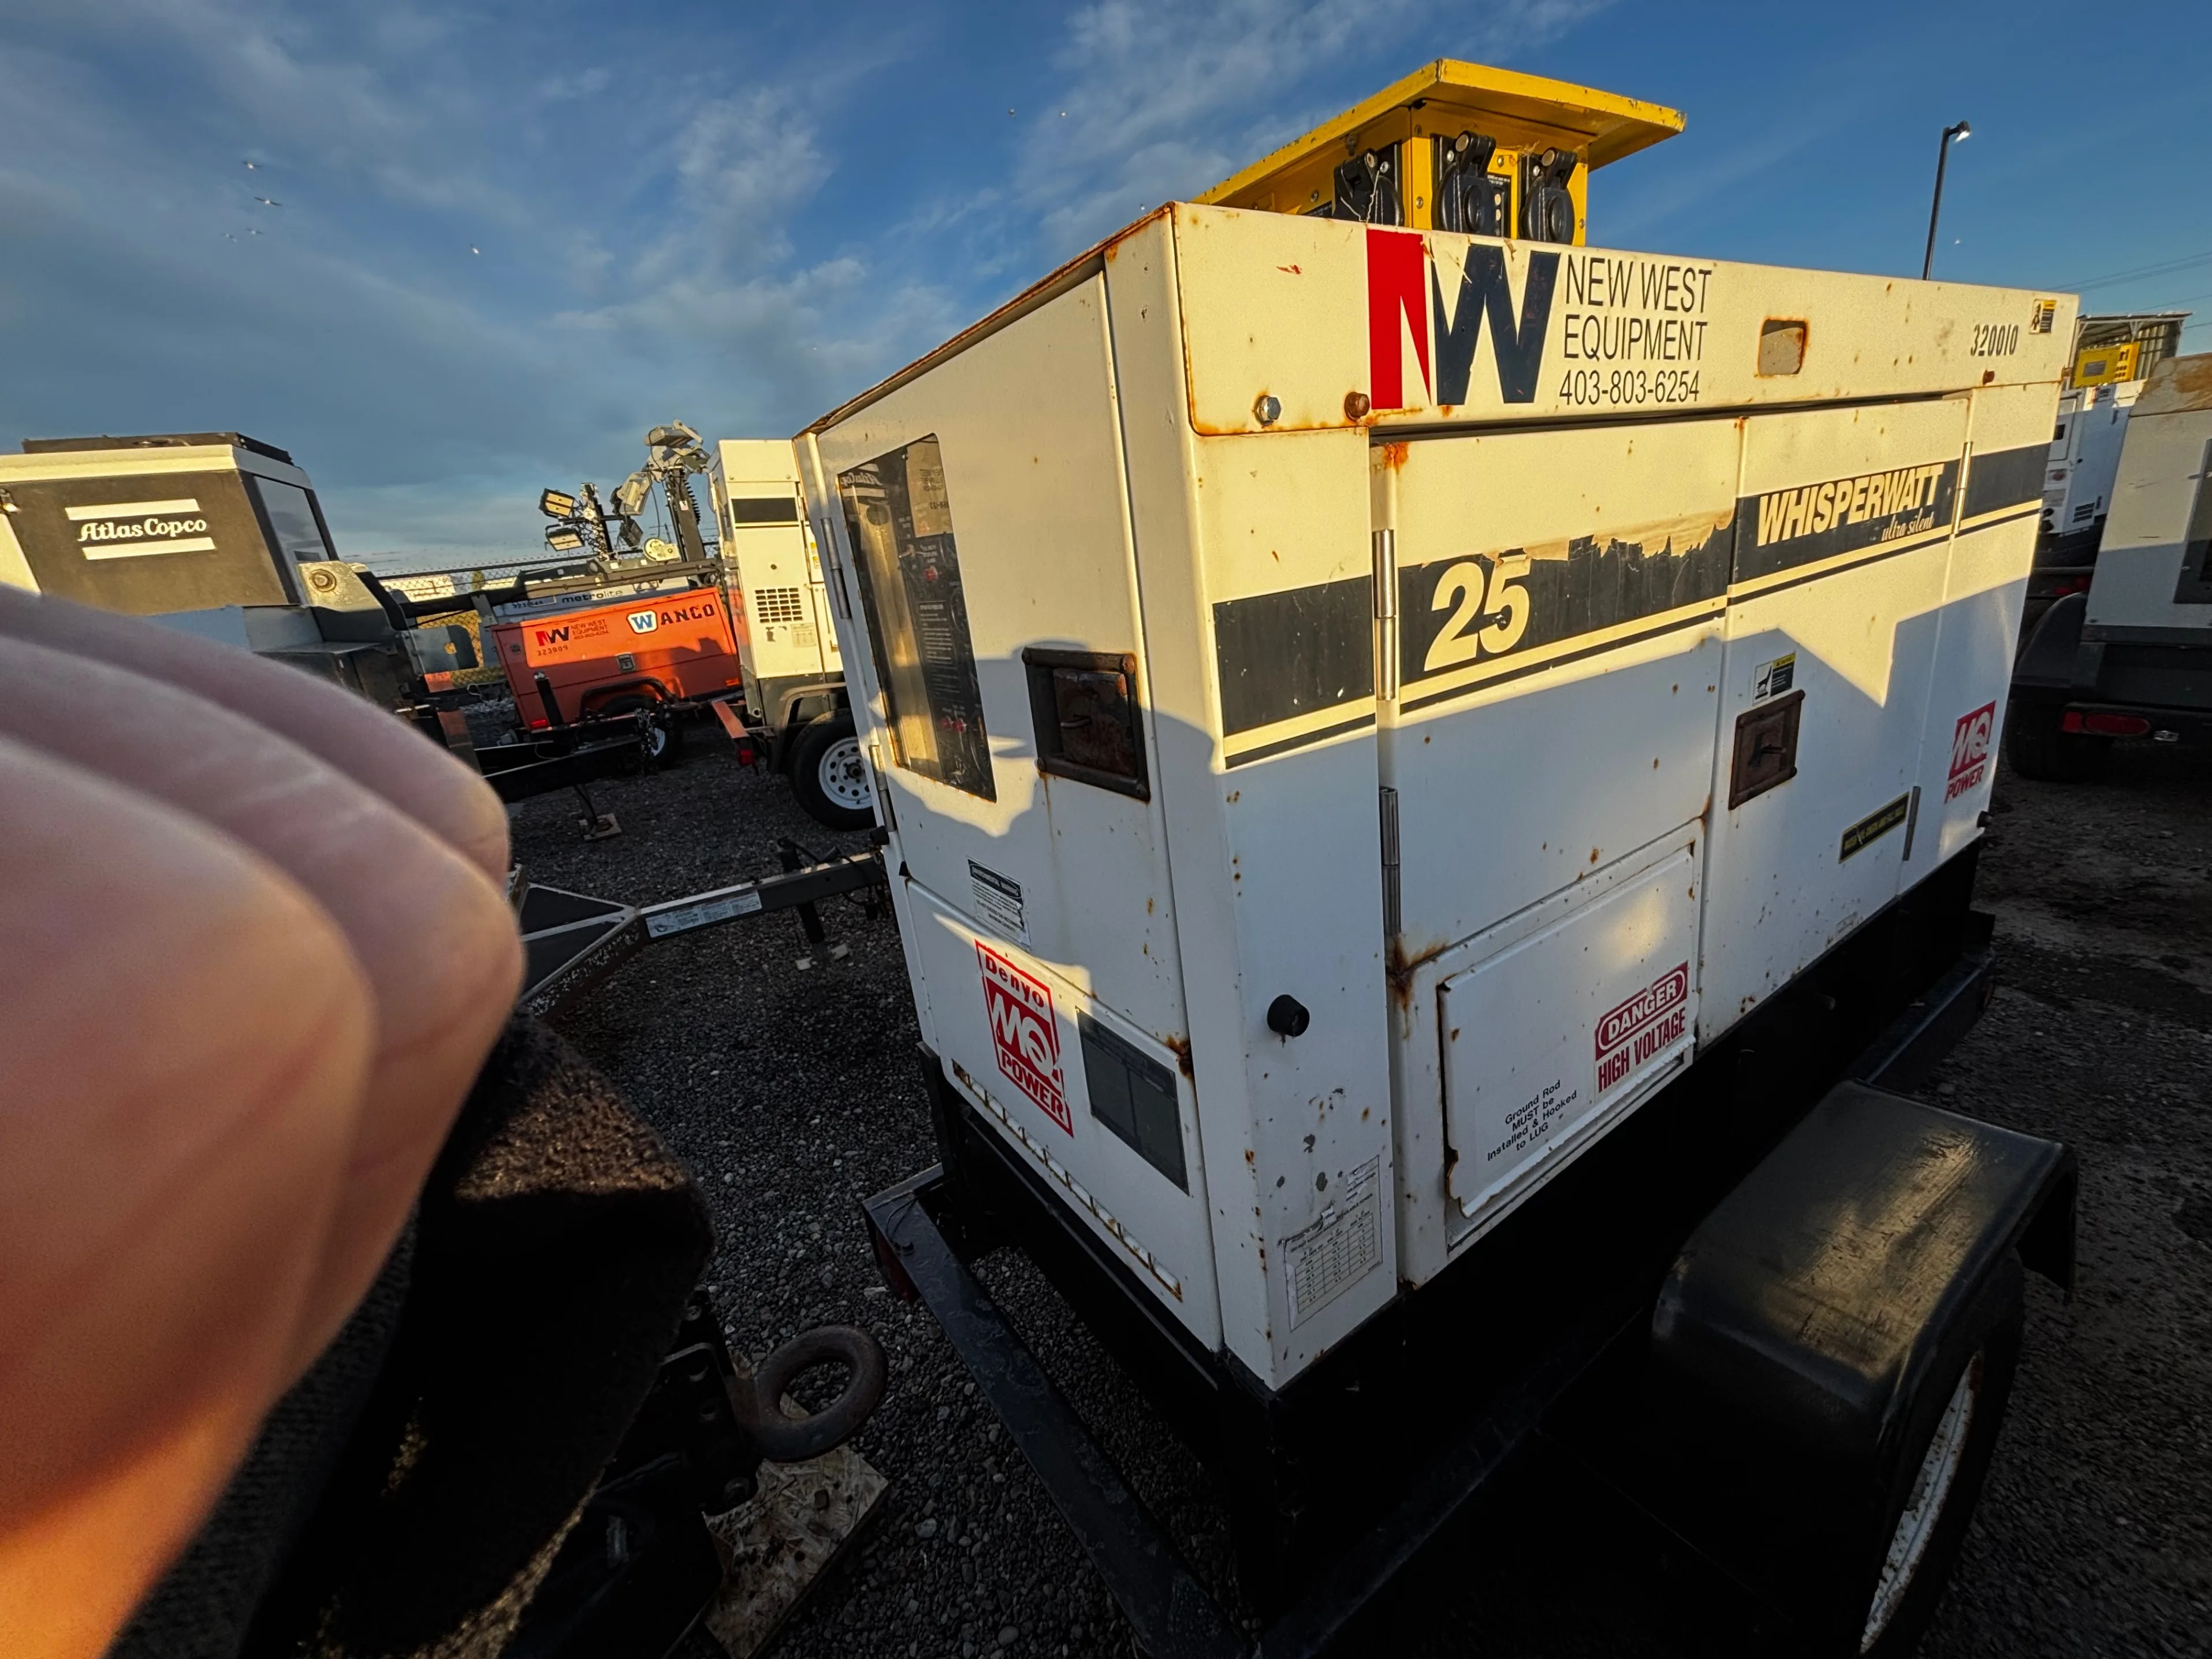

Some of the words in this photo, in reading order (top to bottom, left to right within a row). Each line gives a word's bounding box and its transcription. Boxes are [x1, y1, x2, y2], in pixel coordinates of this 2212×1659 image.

[1566, 254, 1634, 308] NEW
[1640, 263, 1712, 314] WEST
[1563, 314, 1708, 362] EQUIPMENT
[1970, 324, 2019, 356] 320010
[1559, 370, 1700, 406] 403-803-6254
[1757, 463, 1945, 546] WHISPERWATT
[1881, 515, 1906, 542] ultra
[1907, 508, 1934, 536] silent
[77, 522, 144, 542] Atlas
[144, 518, 207, 537] Copco
[561, 590, 623, 604] metrolite
[1424, 556, 1532, 671] 25
[572, 624, 608, 635] EQUIPMENT
[1944, 764, 1984, 804] POWER
[985, 953, 1044, 1008] Denyo
[1607, 979, 1677, 1041] DANGER
[1599, 1046, 1630, 1093] HIGH
[1634, 1007, 1686, 1066] VOLTAGE
[1001, 1051, 1066, 1122] POWER
[1505, 1095, 1539, 1124] Ground
[1543, 1080, 1561, 1098] Rod
[1487, 1125, 1528, 1161] Installed
[1532, 1118, 1539, 1128] &
[1543, 1090, 1577, 1120] Hooked
[1512, 1106, 1539, 1132] MUST
[1543, 1098, 1554, 1109] be
[1516, 1140, 1526, 1151] to
[1529, 1122, 1548, 1141] LUG
